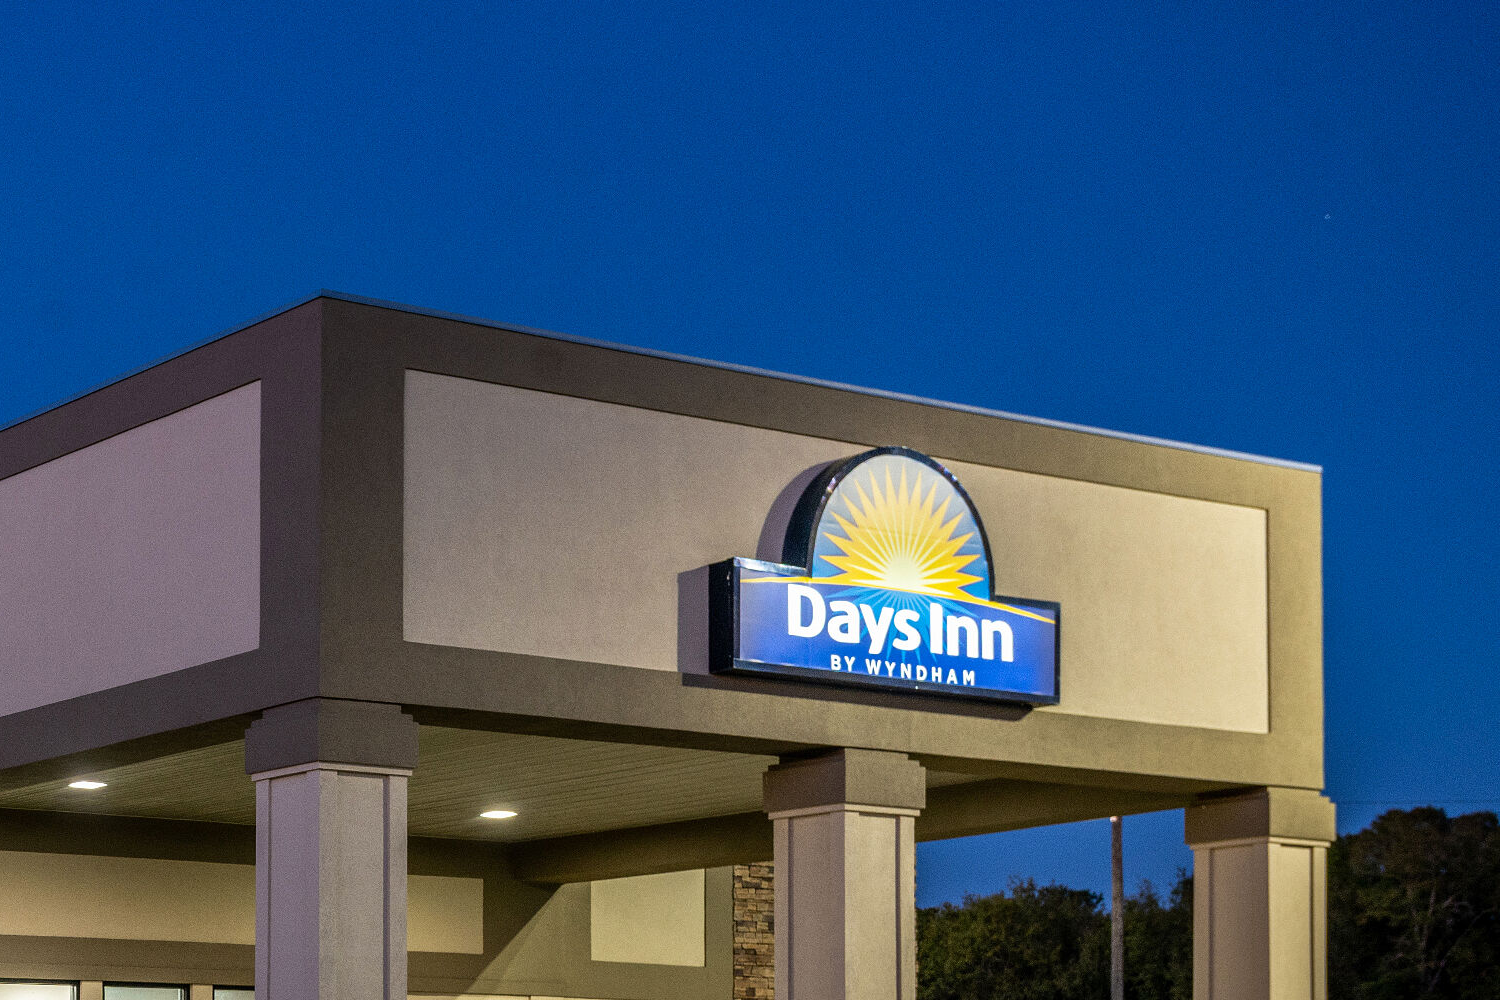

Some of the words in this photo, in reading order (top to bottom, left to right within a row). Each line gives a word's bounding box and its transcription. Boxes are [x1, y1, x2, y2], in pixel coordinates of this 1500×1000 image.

[788, 584, 921, 654] Days
[930, 603, 1014, 662] Inn
[830, 654, 855, 672] BY
[865, 658, 975, 686] WYNDHAM
